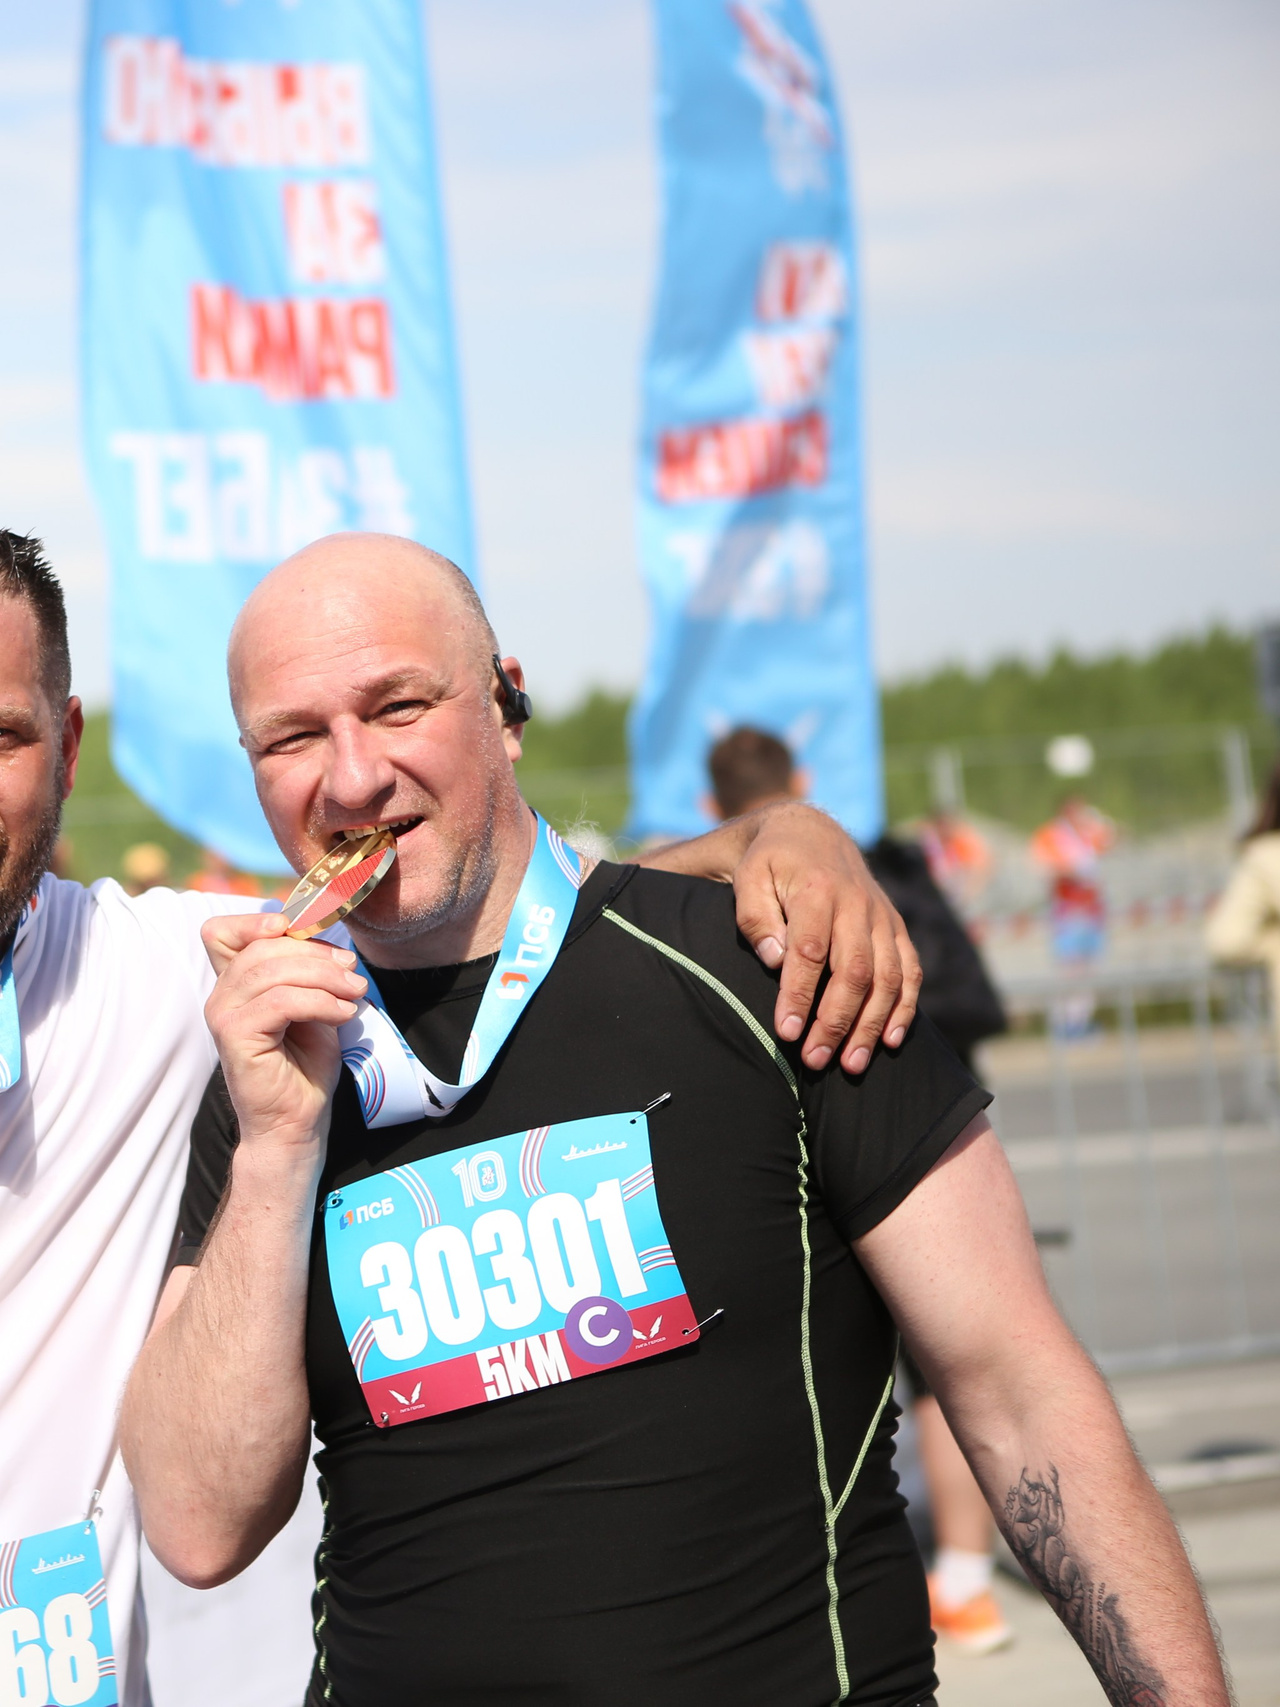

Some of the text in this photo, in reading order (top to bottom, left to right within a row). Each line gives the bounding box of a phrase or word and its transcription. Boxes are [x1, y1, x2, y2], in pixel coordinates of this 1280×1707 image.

[515, 904, 556, 969] ПСБ
[451, 1150, 507, 1208] 10
[356, 1197, 395, 1225] ПСБ
[359, 1178, 648, 1361] 30301
